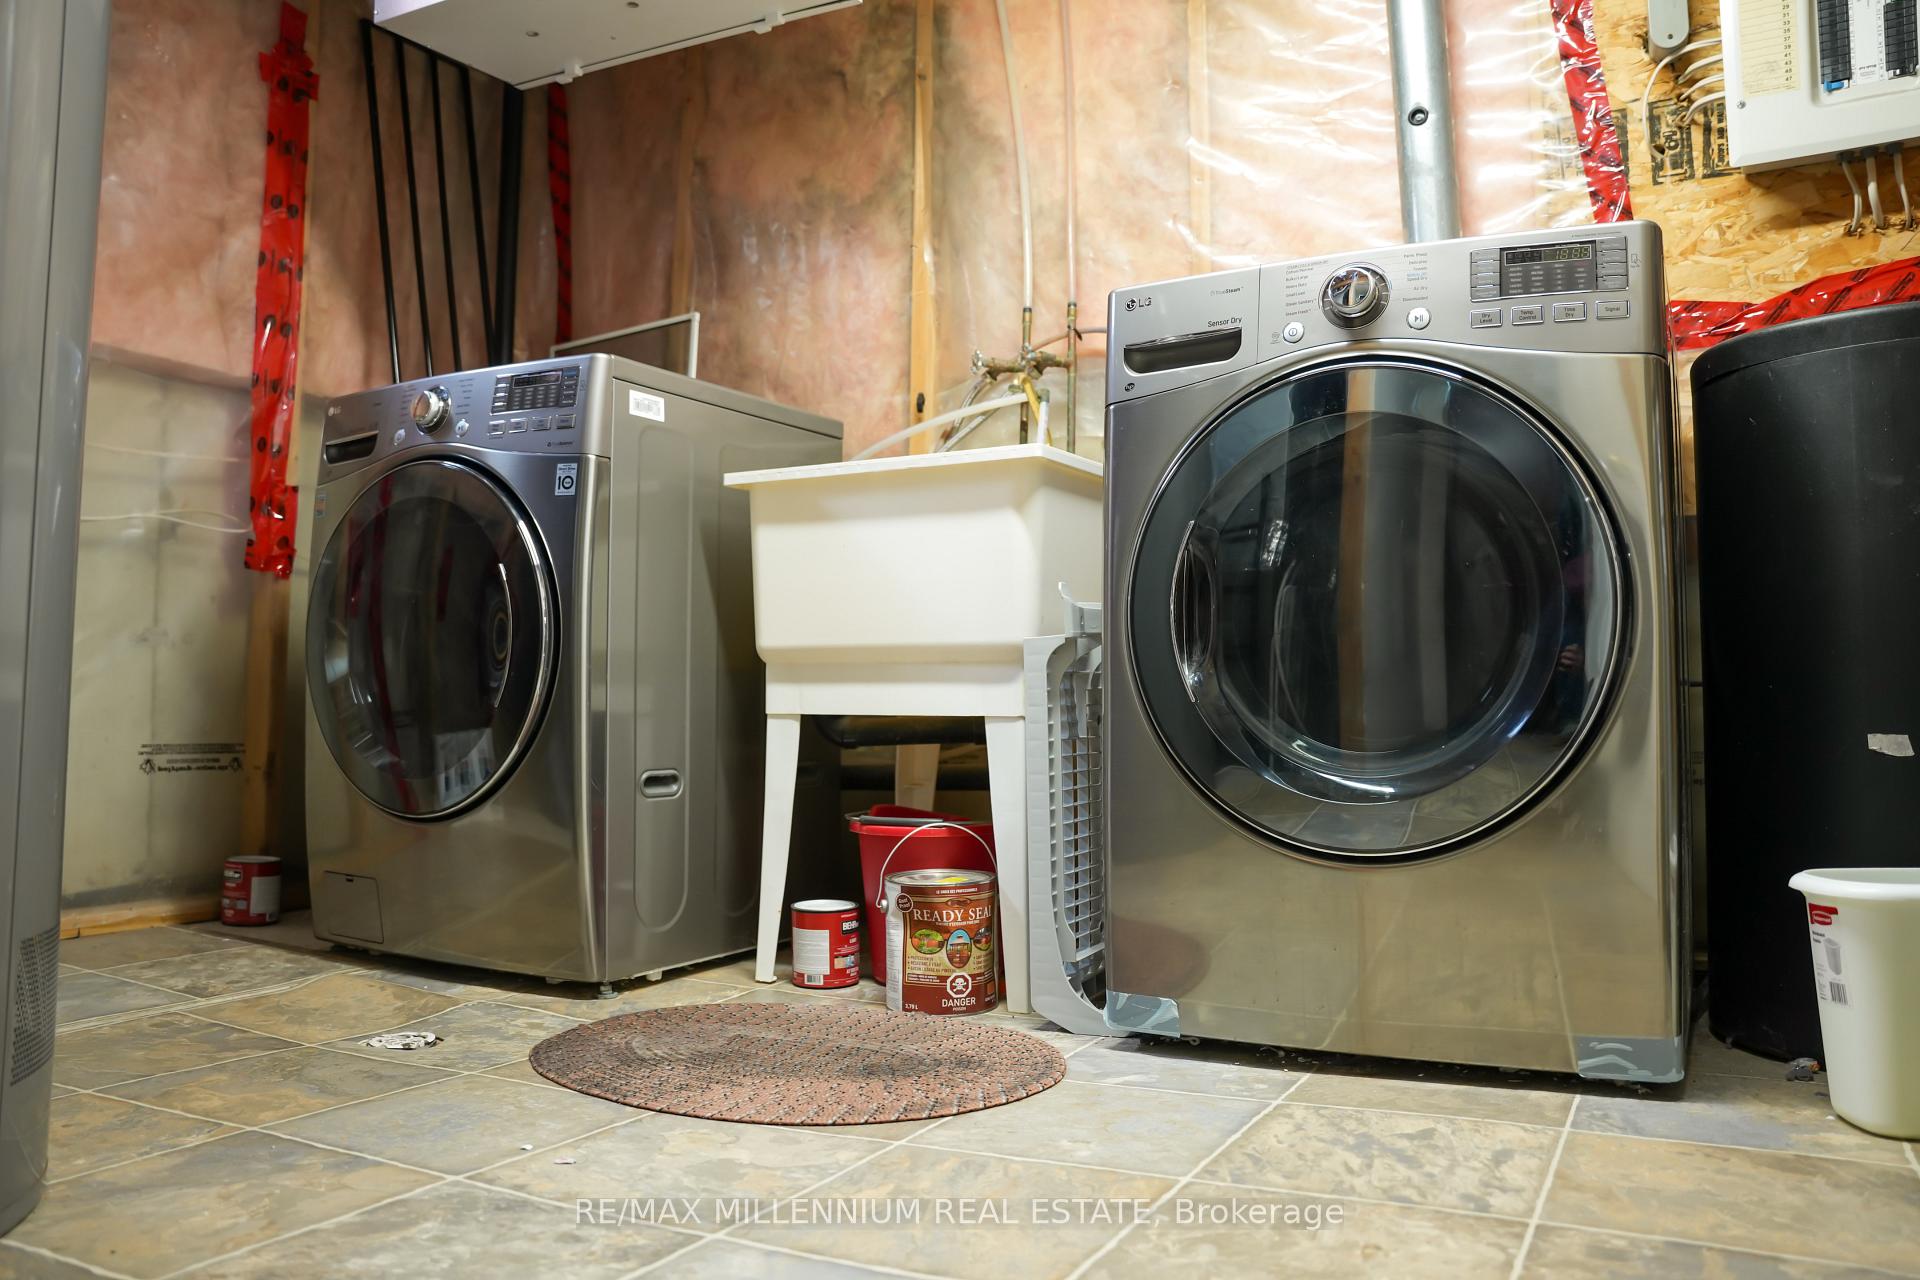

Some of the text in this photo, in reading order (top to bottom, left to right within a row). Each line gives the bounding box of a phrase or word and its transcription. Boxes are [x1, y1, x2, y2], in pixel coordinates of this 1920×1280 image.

[1207, 316, 1243, 328] Sensor Dry
[913, 908, 965, 923] READY
[941, 996, 976, 1008] DANGER
